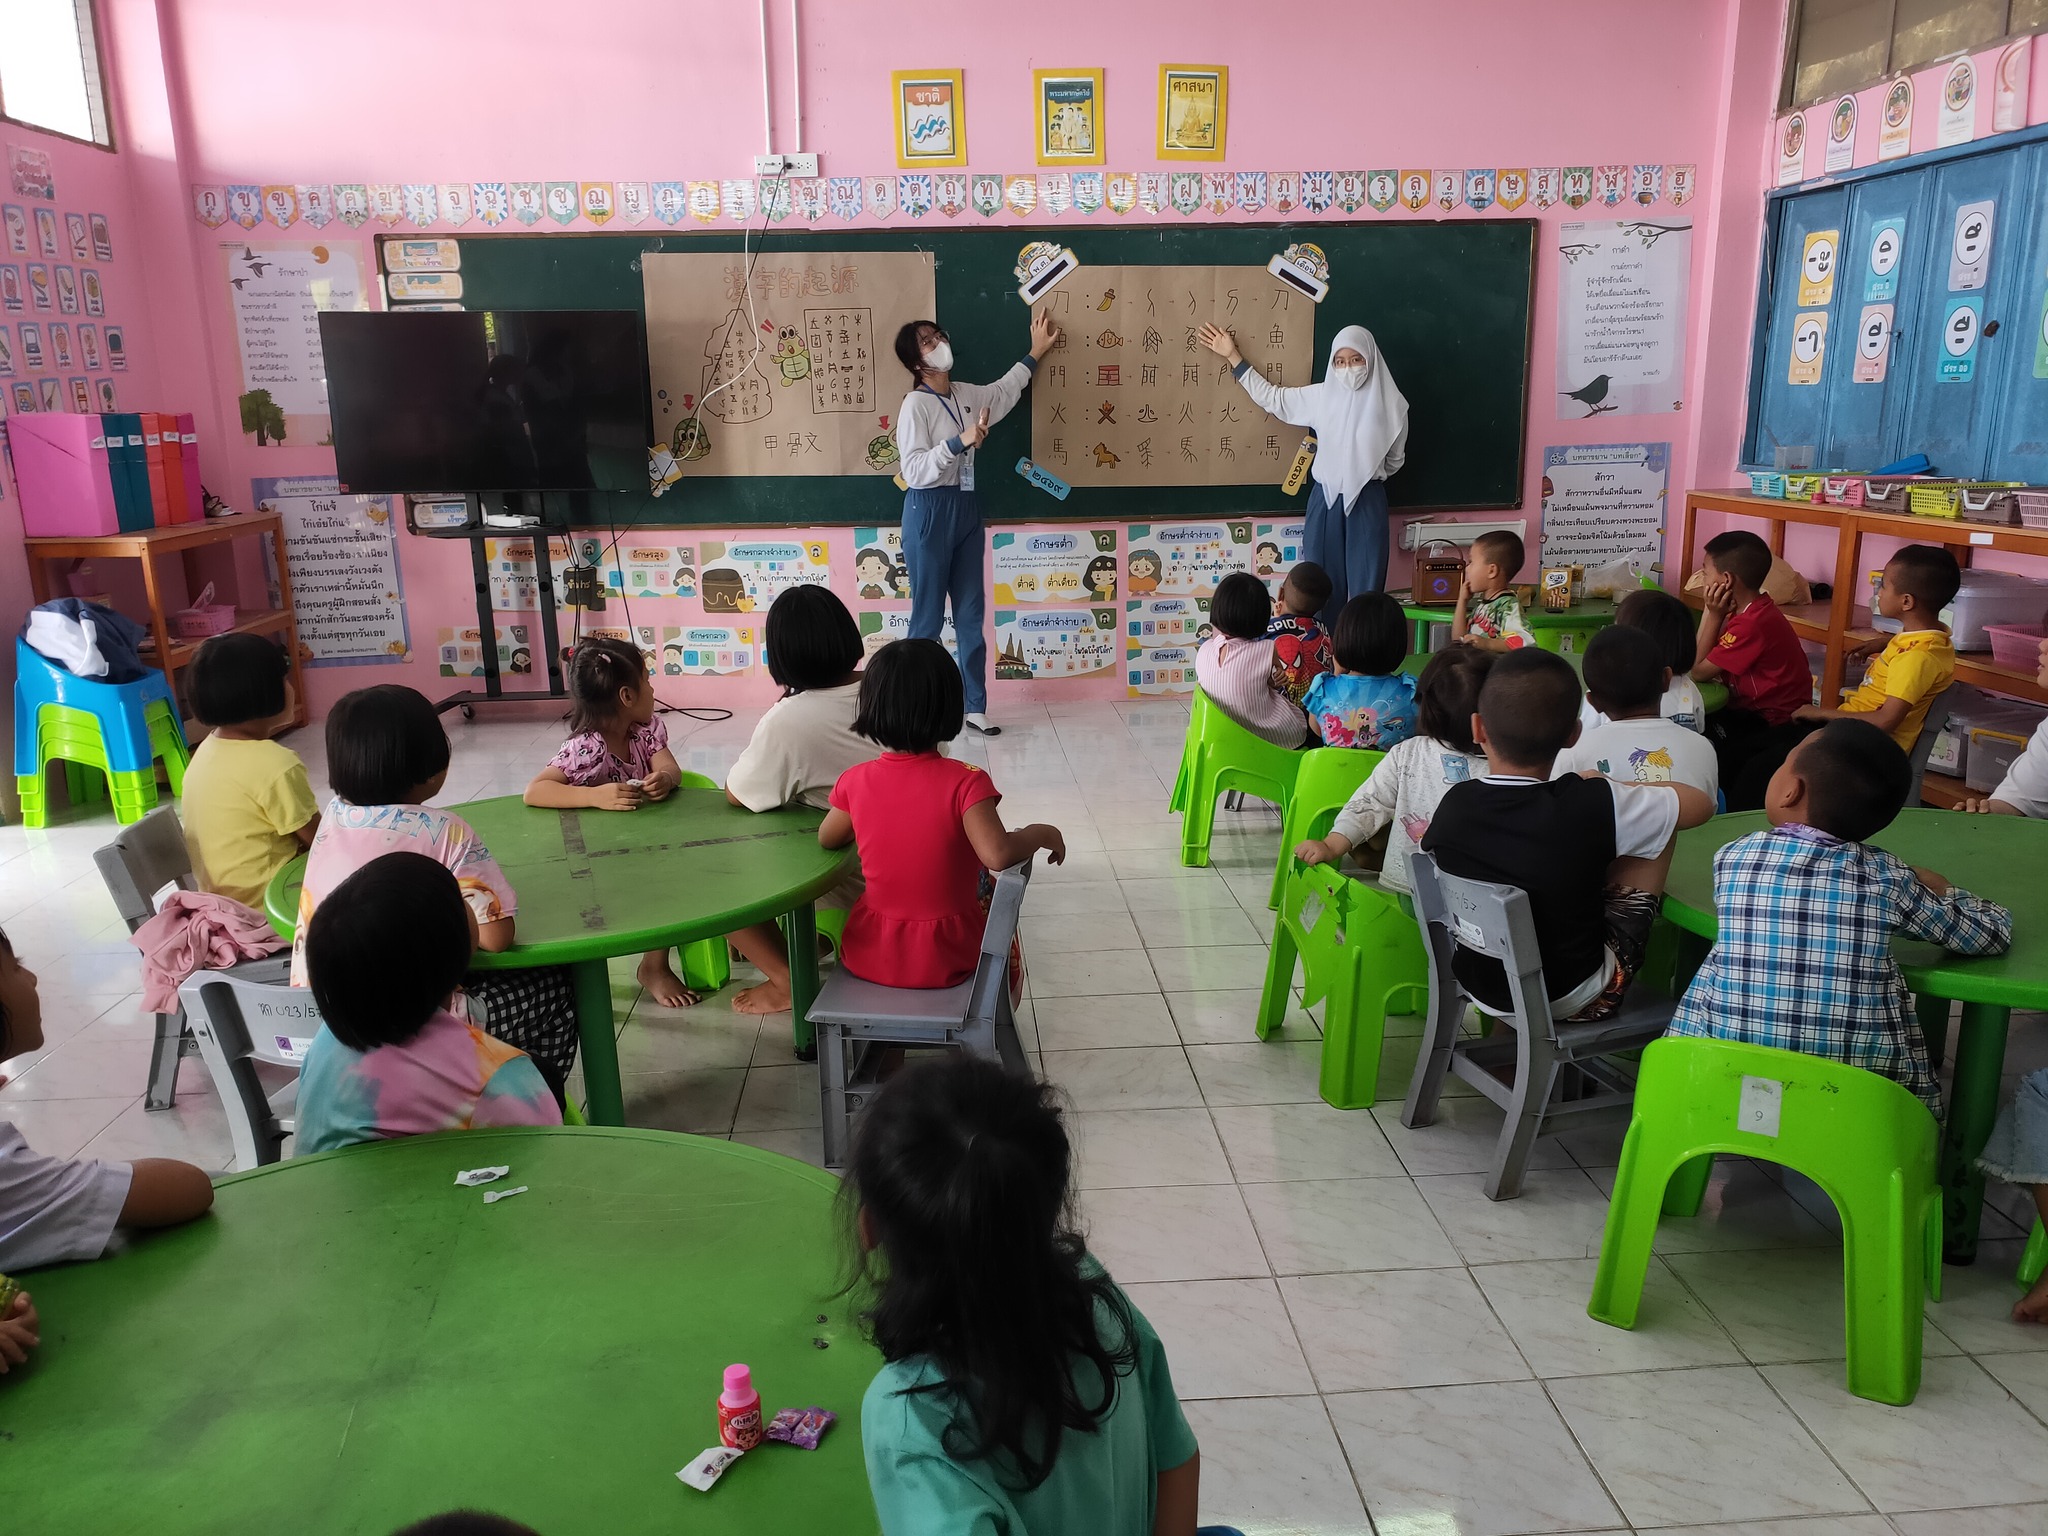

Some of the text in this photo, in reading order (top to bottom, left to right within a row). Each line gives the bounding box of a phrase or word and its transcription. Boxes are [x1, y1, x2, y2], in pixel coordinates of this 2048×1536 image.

[1049, 88, 1091, 99] พระมหากษัตริย์
[1173, 79, 1213, 95] ศาสนา
[916, 87, 940, 103] ชาติ
[1277, 178, 1290, 192] ภ
[1311, 178, 1322, 192] ม
[1344, 178, 1354, 192] ย
[1378, 178, 1386, 191] ร
[1410, 177, 1421, 191] ล
[1443, 178, 1452, 191] ว
[1474, 177, 1485, 191] ศ
[1505, 175, 1519, 190] ษ
[1538, 174, 1549, 189] ส
[1571, 174, 1583, 188] ห
[1605, 173, 1618, 188] ฬ
[1642, 172, 1652, 186] อ
[1675, 172, 1686, 186] ฮ
[838, 186, 854, 200] ณ
[875, 184, 886, 197] ด
[910, 182, 922, 196] ต
[945, 180, 955, 195] ถ
[980, 181, 993, 196] ท
[1081, 180, 1093, 194] บ
[1113, 178, 1125, 196] ป
[1181, 178, 1193, 198] ฝ
[1212, 180, 1226, 194] พ
[1243, 179, 1256, 198] ฟ
[205, 192, 216, 206] ก
[310, 193, 320, 206] ค
[415, 193, 423, 206] ง
[449, 192, 459, 206] จ
[485, 190, 497, 204] ฉ
[519, 189, 531, 204] ช
[589, 190, 604, 203] ฌ
[1297, 260, 1314, 274] เดือน
[724, 265, 860, 302] 漢字的起源
[1052, 290, 1070, 314] 刀
[1270, 290, 1289, 310] 刀
[1266, 323, 1285, 349] 魚
[1050, 366, 1066, 387] 門
[1050, 402, 1067, 424] 火
[764, 432, 822, 458] 甲骨文
[1048, 438, 1068, 465] 馬
[1260, 435, 1280, 460] 馬
[1594, 472, 1614, 481] สักวา
[310, 500, 337, 512] ไก่แจ้
[1160, 528, 1211, 540] อักษรต่ำจำง่าย
[1033, 535, 1072, 550] อักษรต่ำ
[632, 550, 664, 560] อักษรสูง
[733, 549, 790, 557] อักษรกลางจำง่าย
[1018, 574, 1078, 591] ต่ำคู่ ต่ำเดี่ยว
[295, 594, 381, 612] ถึงคุณครูผู้ฝึกสอนสั่ง
[1154, 602, 1182, 612] อักษรต่ำ
[1022, 614, 1079, 628] อักษรต่ำจำง่าย
[300, 627, 385, 642] คงตั้งแต่สุขทุกวันเอย
[690, 632, 726, 640] อักษรกลาง
[1155, 650, 1182, 660] อักษรต่ำ
[280, 1039, 288, 1048] 2
[1756, 1110, 1763, 1121] 9
